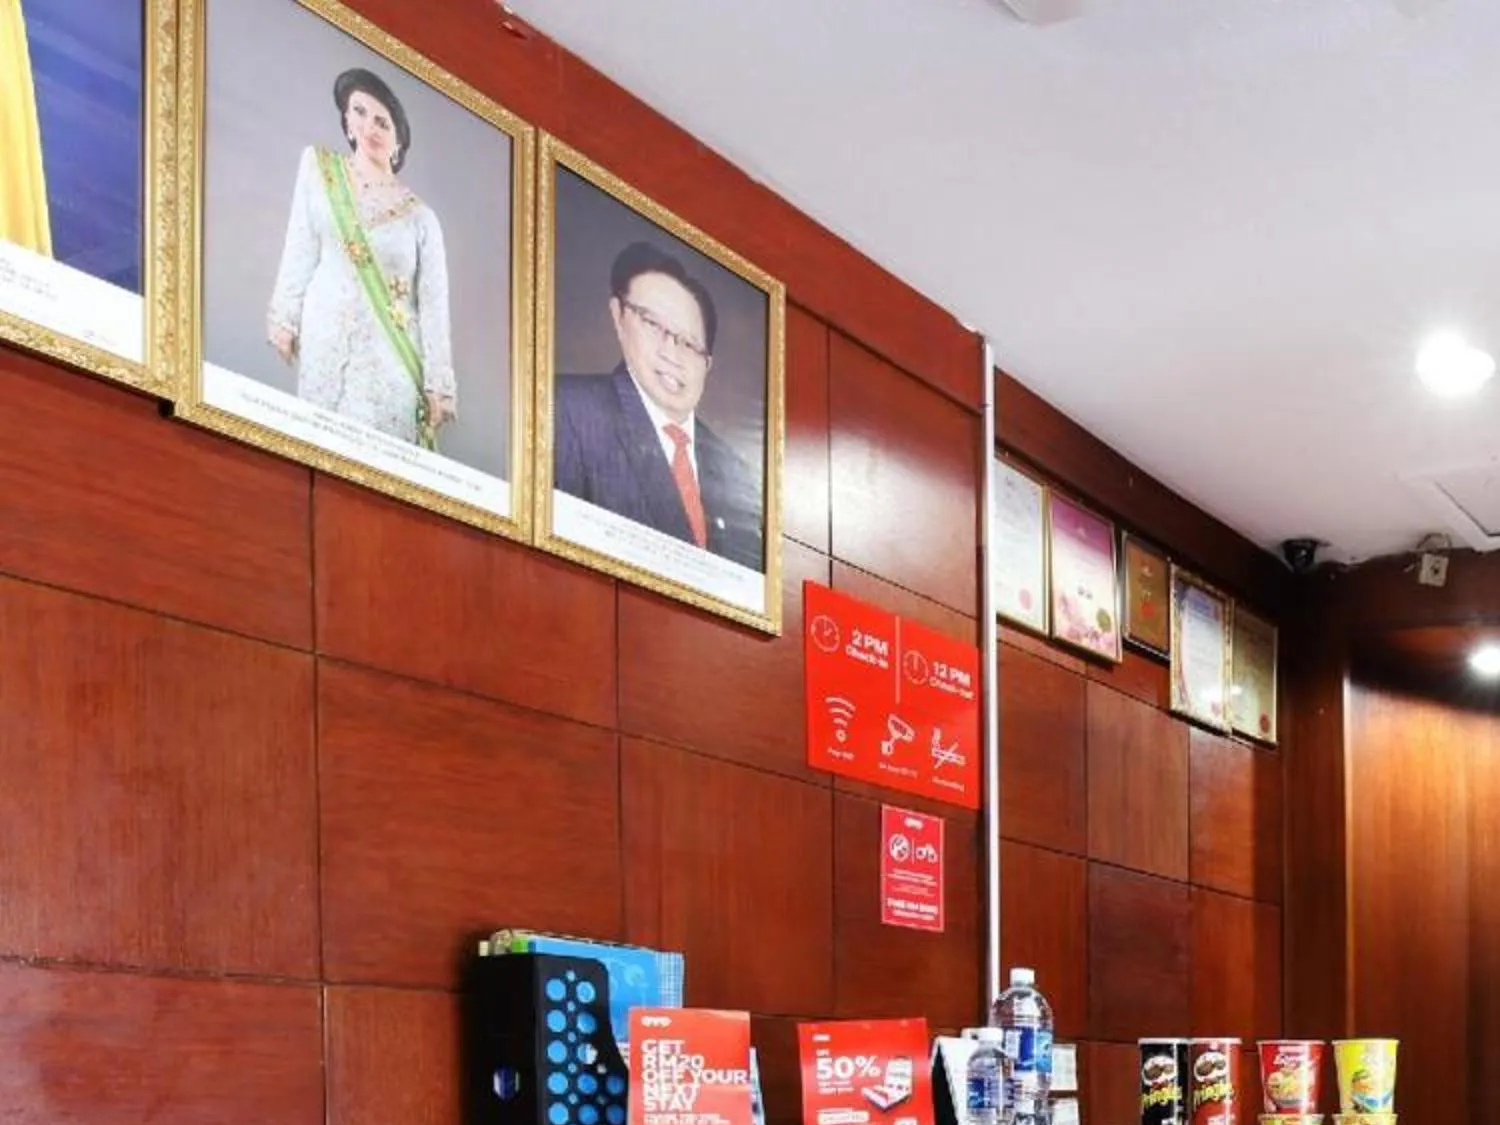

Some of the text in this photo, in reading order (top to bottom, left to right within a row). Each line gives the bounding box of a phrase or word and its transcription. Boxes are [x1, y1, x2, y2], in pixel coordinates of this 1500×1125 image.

[852, 629, 888, 656] 2 PM
[933, 661, 971, 687] 12 PM
[641, 1039, 685, 1054] GET
[643, 1054, 705, 1069] RM20
[816, 1056, 881, 1080] 50%
[642, 1068, 748, 1085] OFF YOUR
[643, 1084, 698, 1098] NEXT
[643, 1098, 694, 1111] STAY
